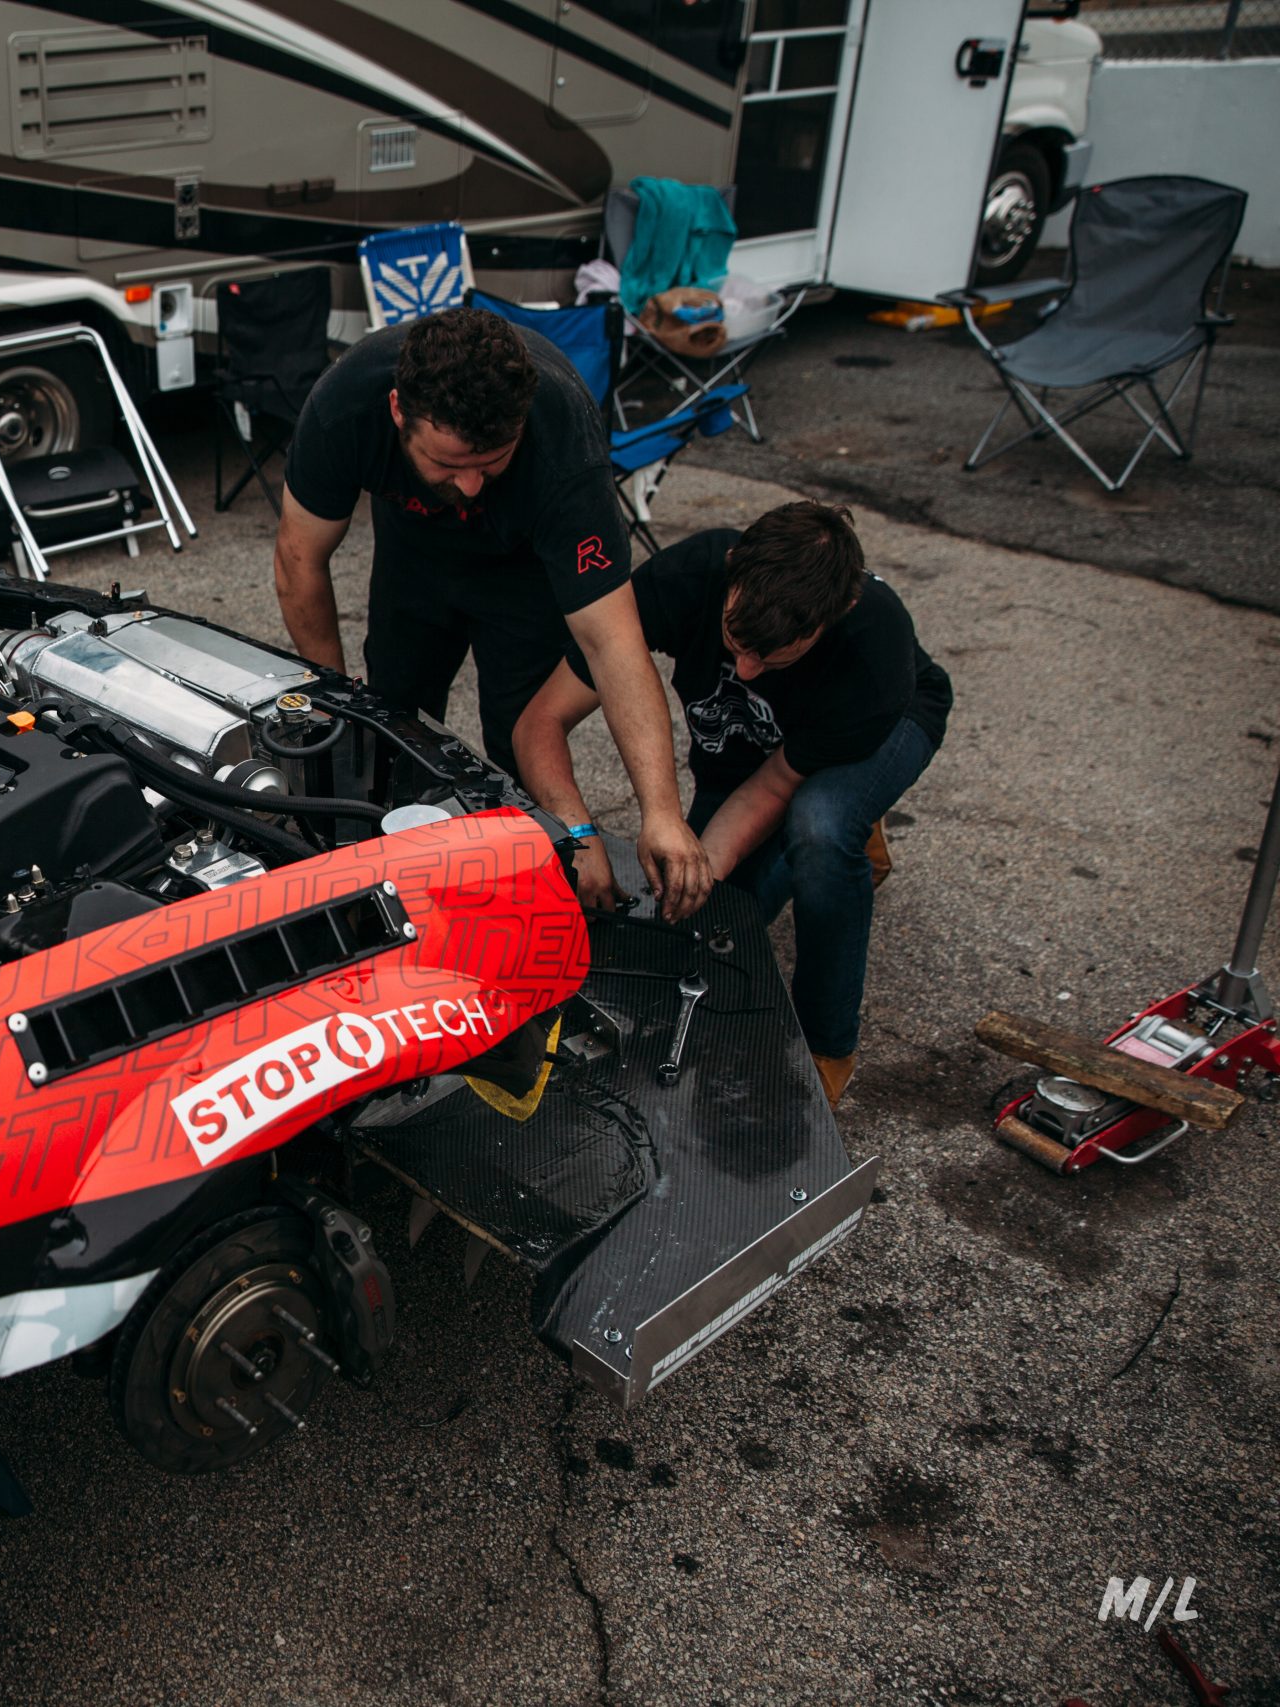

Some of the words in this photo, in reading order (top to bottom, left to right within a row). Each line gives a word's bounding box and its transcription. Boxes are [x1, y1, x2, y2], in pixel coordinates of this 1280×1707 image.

[577, 535, 613, 574] R
[651, 1272, 783, 1378] PROFESSIONAL
[787, 1207, 864, 1274] AWESOME
